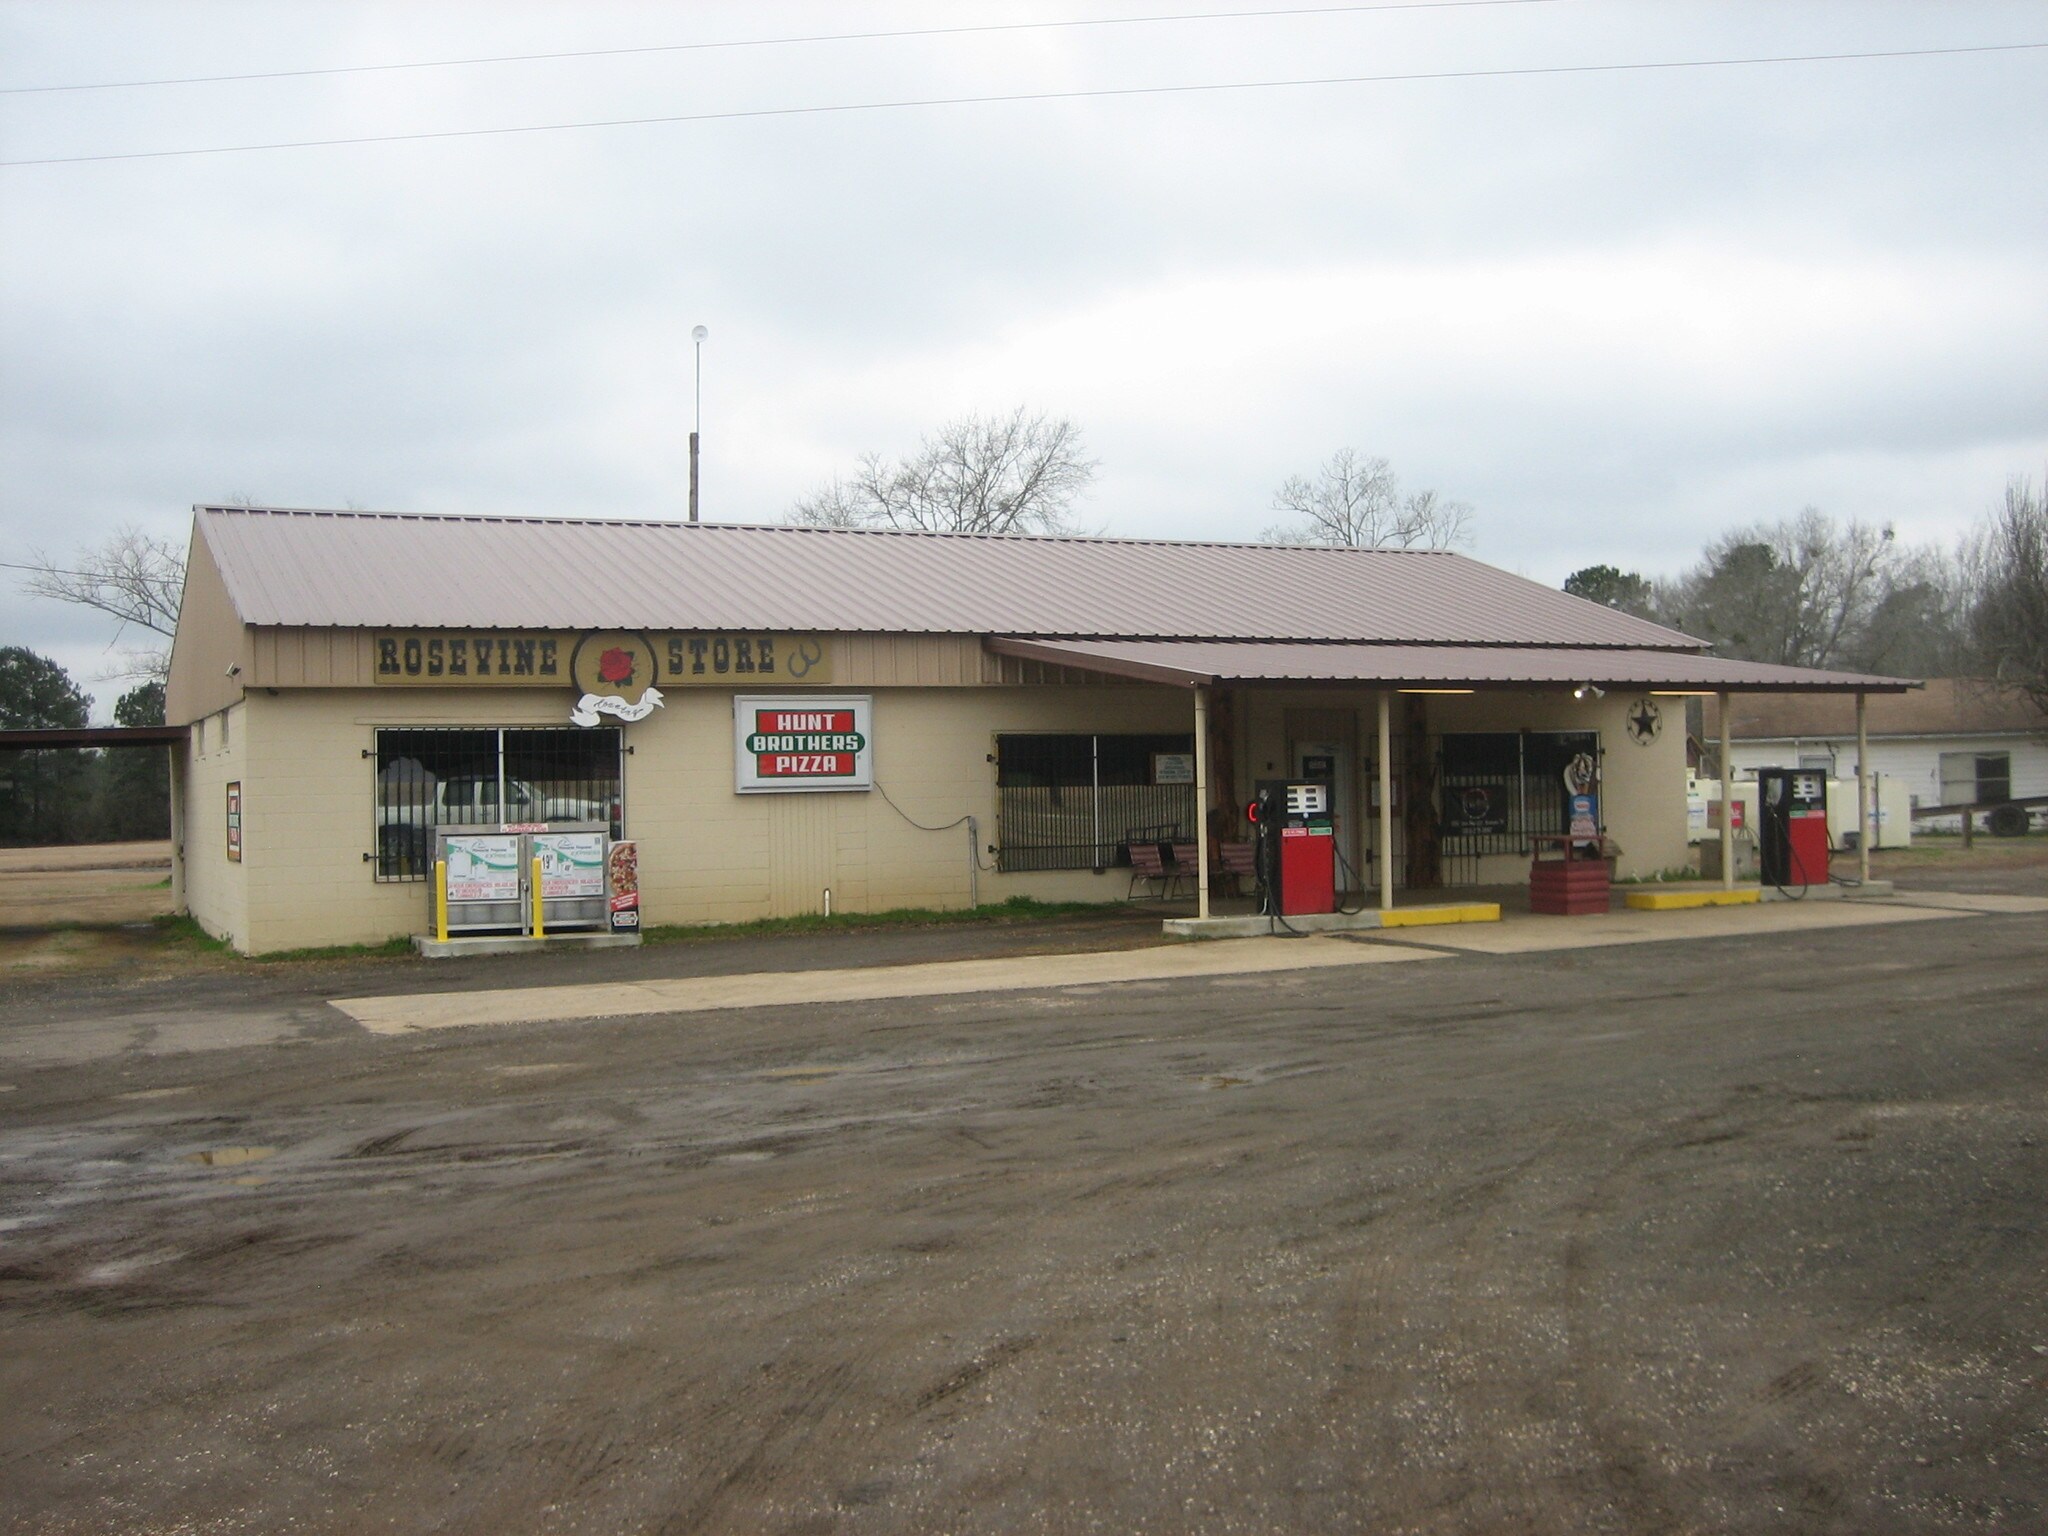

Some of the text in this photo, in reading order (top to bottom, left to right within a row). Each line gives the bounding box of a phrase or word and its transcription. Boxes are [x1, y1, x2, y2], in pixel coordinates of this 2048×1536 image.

[378, 637, 775, 676] ROSEVINE STORE
[777, 713, 836, 731] HUNT
[753, 735, 859, 751] BROTHERS
[776, 755, 837, 773] PIZZA
